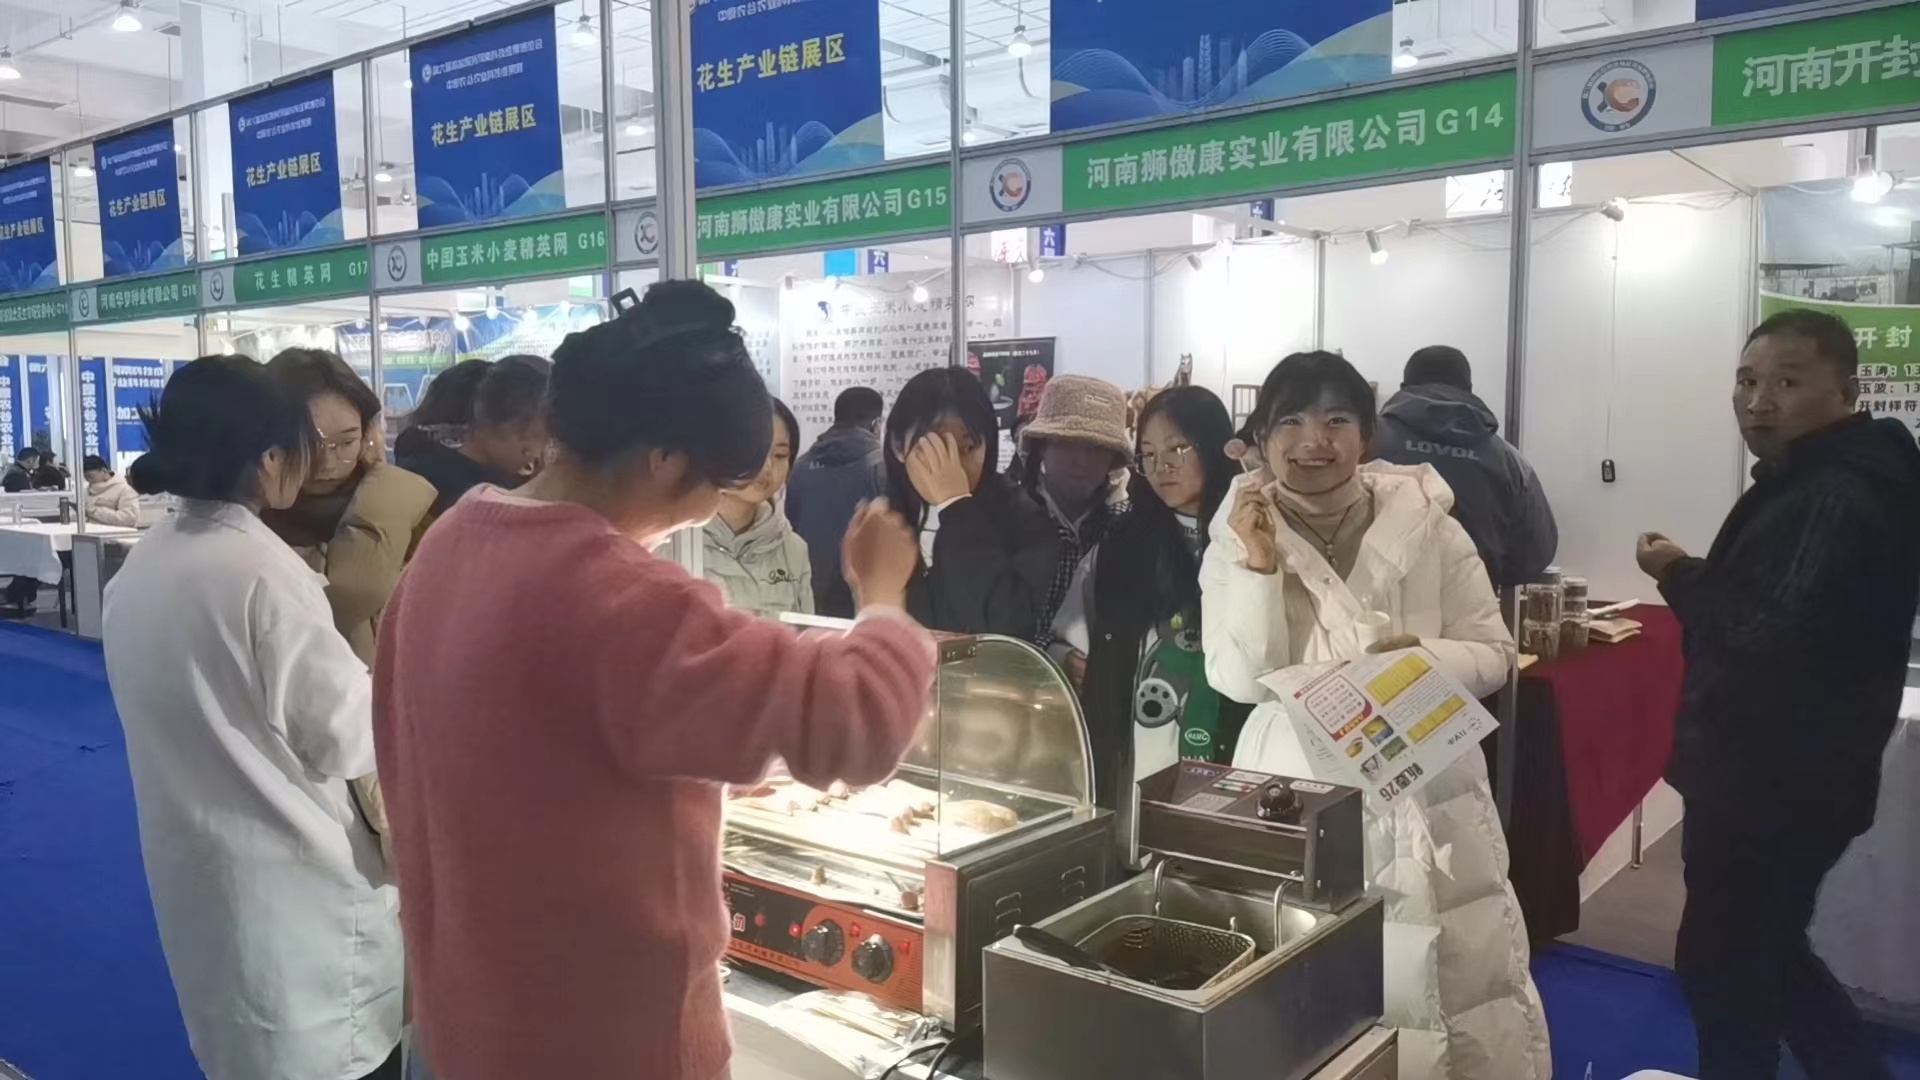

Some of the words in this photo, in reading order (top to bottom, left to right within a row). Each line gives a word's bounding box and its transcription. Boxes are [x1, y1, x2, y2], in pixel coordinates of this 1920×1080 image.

[696, 33, 846, 92] 花生产业链展区
[1742, 34, 1920, 97] 河南开封
[431, 103, 537, 147] 花生产业链展区
[1087, 108, 1426, 189] 河南狮傲康实业有限公司
[1436, 102, 1504, 135] G14
[245, 152, 322, 188] 花生产业链展区
[696, 188, 902, 239] 河南狮傲康实业有限公司
[906, 186, 947, 209] G15
[427, 232, 568, 271] 中国玉米小麦精英网
[577, 231, 605, 249] G16
[254, 262, 332, 291] 花生精英网
[348, 261, 368, 277] G17
[1852, 325, 1912, 349] 开封
[1405, 440, 1480, 461] LOVOL
